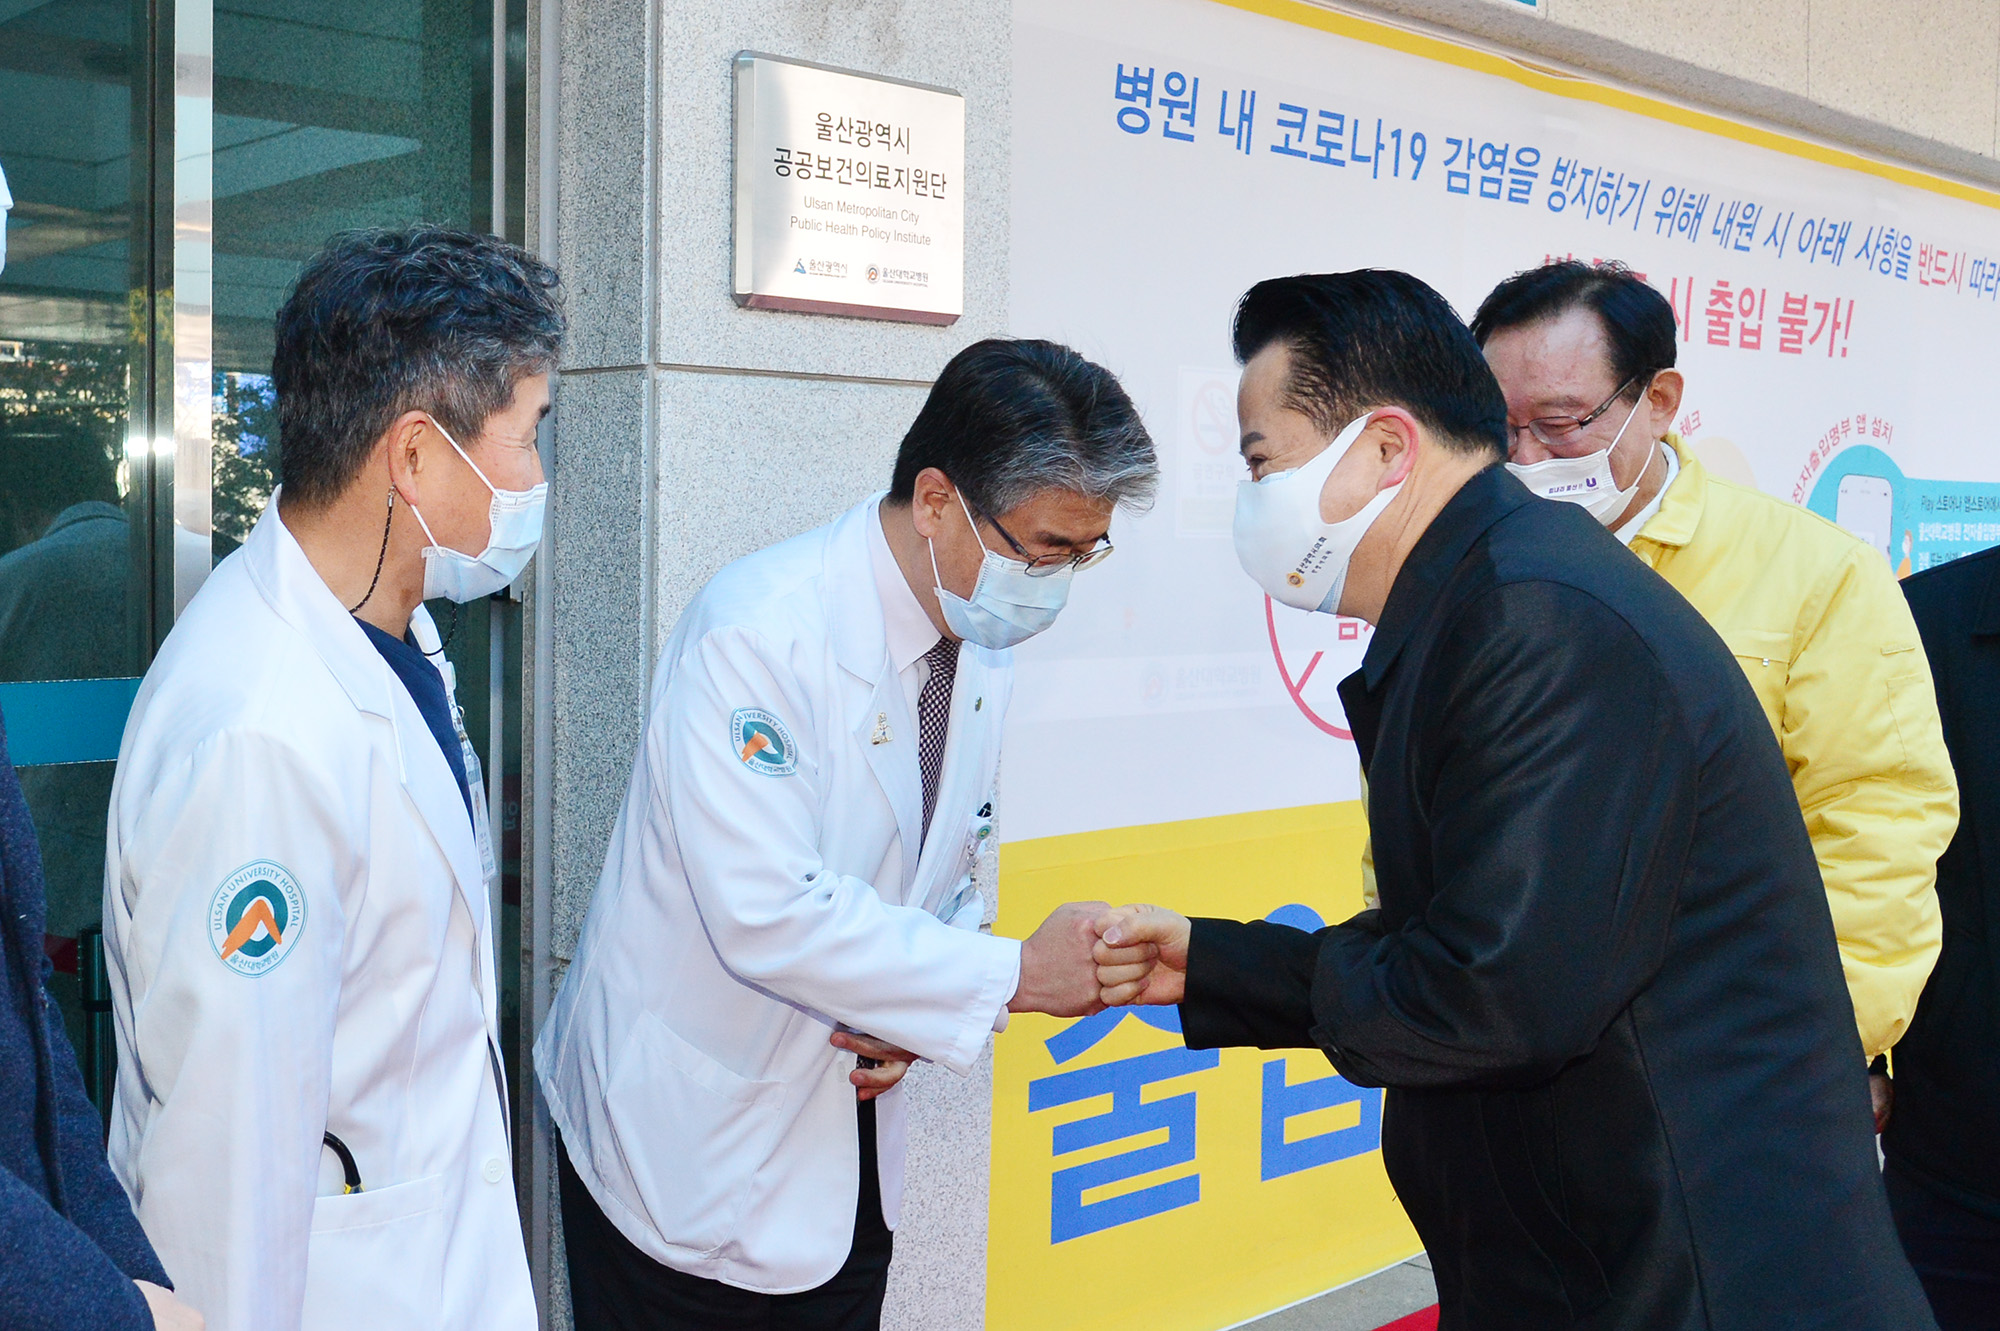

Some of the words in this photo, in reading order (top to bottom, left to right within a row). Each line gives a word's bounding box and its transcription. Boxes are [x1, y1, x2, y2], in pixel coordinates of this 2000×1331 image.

[815, 112, 910, 155] 울산광역시
[774, 147, 947, 200] 공공보건의료지원단
[1114, 63, 1199, 143] 병원
[1218, 90, 1257, 155] 내
[1270, 102, 1427, 181] 코로나19
[1443, 137, 1541, 205] 감염을
[1547, 156, 1650, 231] 방지하기
[1654, 186, 1710, 243] 위해
[1711, 200, 1763, 253] 내원
[1763, 211, 1795, 259] 시
[1798, 217, 1852, 266] 아래
[1854, 225, 1912, 281] 사항을
[1918, 242, 1966, 295] 반드시
[790, 215, 822, 232] Public
[825, 221, 858, 236] Health
[861, 225, 891, 243] Policy
[894, 230, 931, 246] Institute
[804, 195, 834, 211] Ulsan
[836, 200, 898, 220] Metropolitan
[900, 209, 920, 226] City
[809, 259, 848, 274] 울산광역시
[882, 267, 929, 283] 울산대학교병원
[1705, 279, 1767, 351] 출입
[1777, 291, 1855, 358] 불가!
[1680, 409, 1702, 438] 체크
[1791, 417, 1851, 504] 전자출입명부
[1855, 413, 1867, 435] 앱
[1871, 416, 1893, 445] 설치
[214, 892, 229, 930] ULSAN
[227, 867, 281, 892] UNIVERSITY
[280, 878, 300, 927] HOSPITAL
